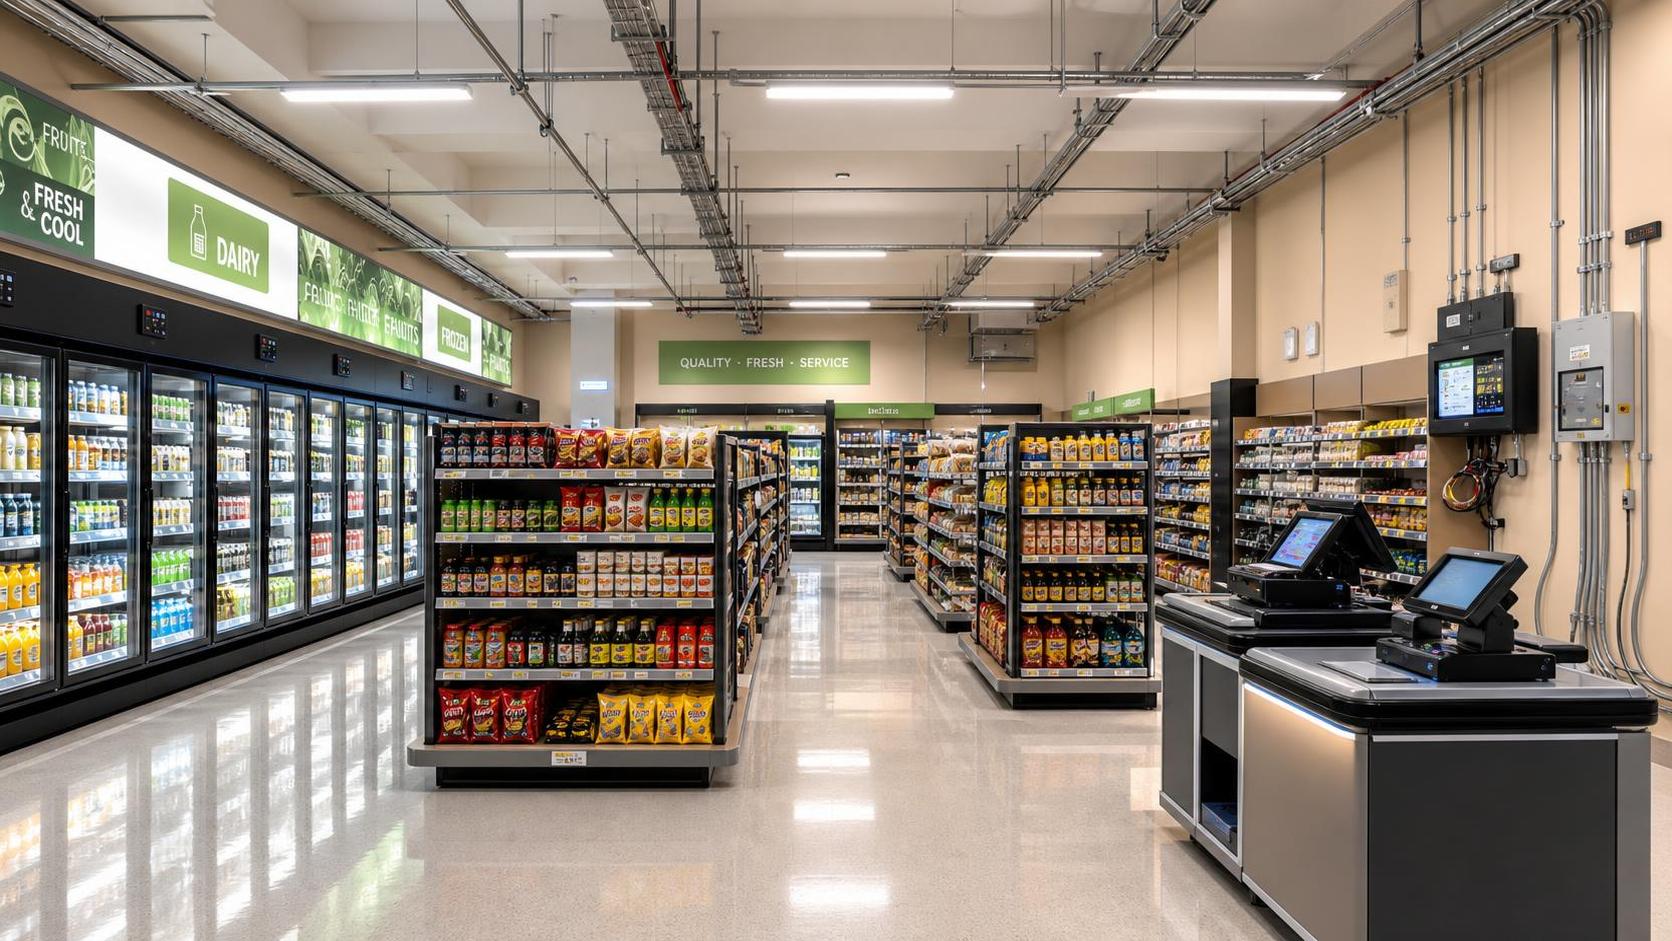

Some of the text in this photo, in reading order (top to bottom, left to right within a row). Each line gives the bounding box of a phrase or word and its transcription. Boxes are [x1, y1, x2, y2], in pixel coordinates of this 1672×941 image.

[20, 190, 36, 221] &
[34, 182, 84, 221] FRESH
[40, 211, 84, 246] COOL
[216, 236, 260, 278] DAIRY
[441, 326, 469, 354] FROZEN
[679, 356, 849, 370] QUALITY FRESH SERVICE
